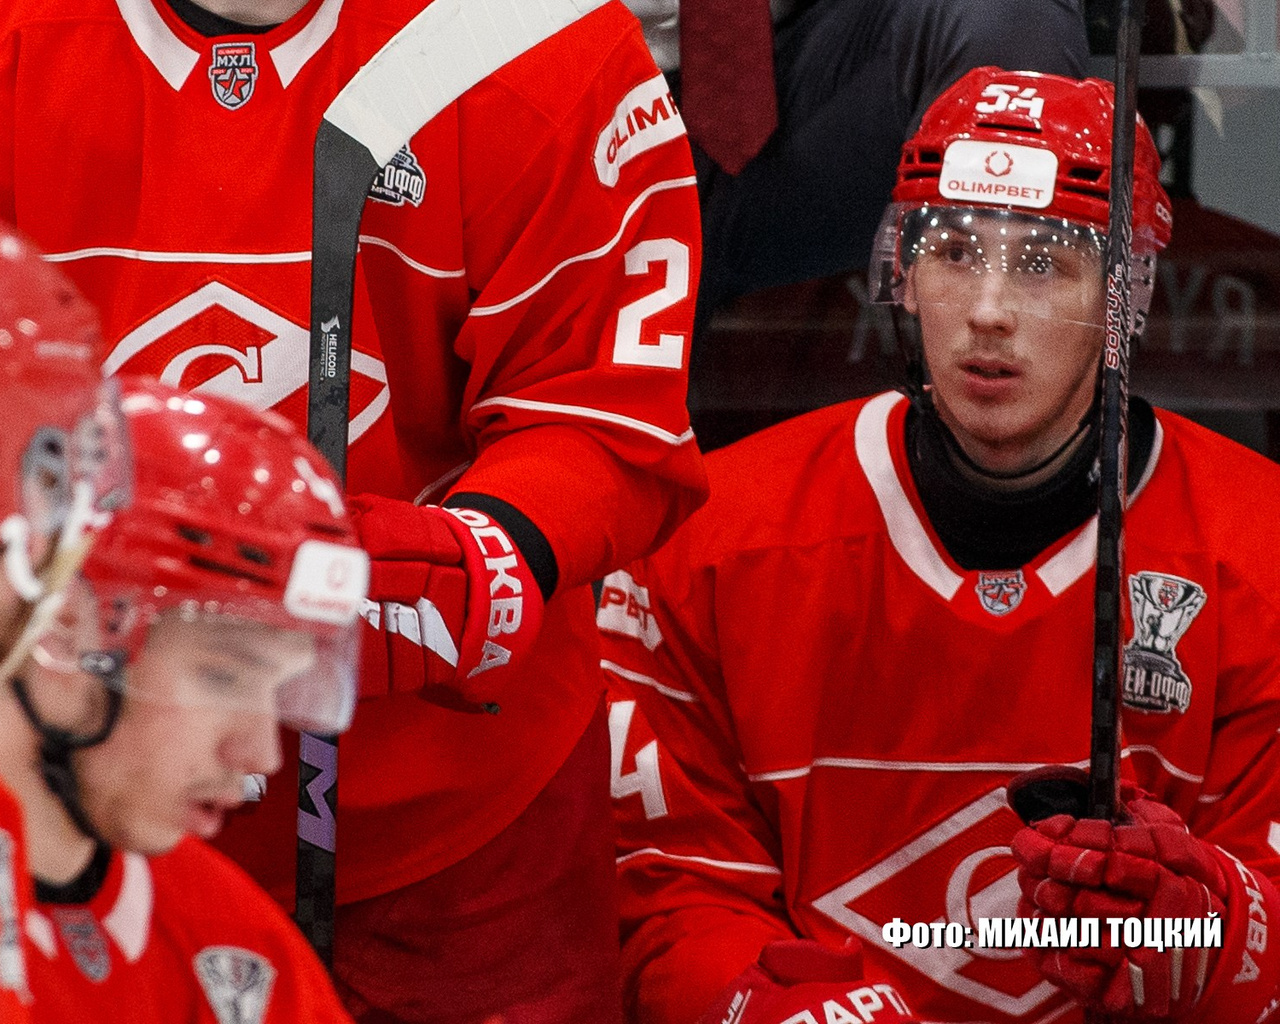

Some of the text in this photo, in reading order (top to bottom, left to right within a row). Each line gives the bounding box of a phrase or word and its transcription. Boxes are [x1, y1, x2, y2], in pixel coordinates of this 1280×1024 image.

[217, 55, 251, 67] МХЛ
[975, 84, 1045, 119] 54
[947, 180, 1045, 200] OLIMPBET
[613, 237, 690, 369] 2
[1105, 273, 1123, 370] SOYUZ
[327, 333, 338, 378] HELICOID
[608, 700, 668, 820] 4
